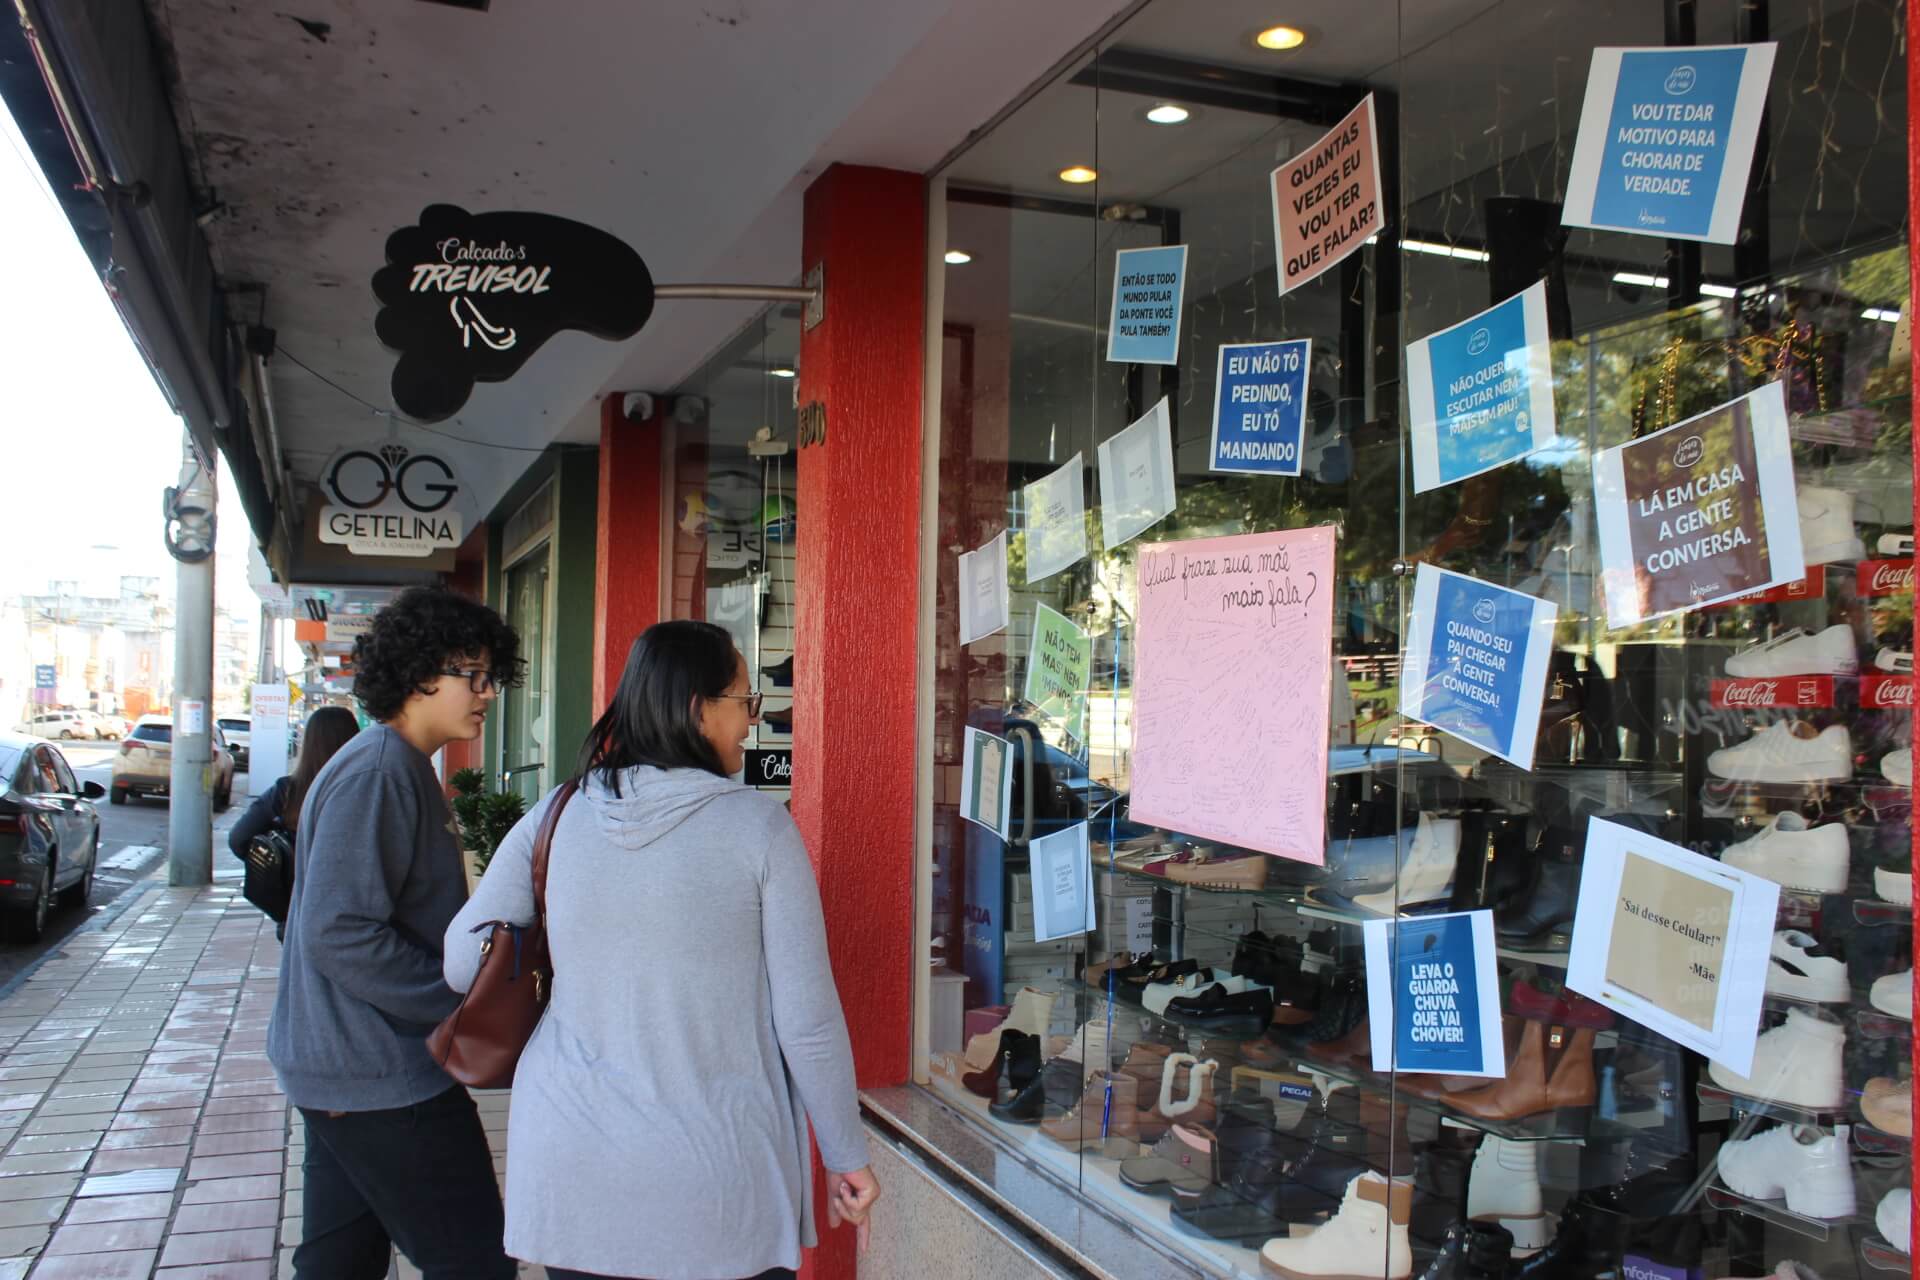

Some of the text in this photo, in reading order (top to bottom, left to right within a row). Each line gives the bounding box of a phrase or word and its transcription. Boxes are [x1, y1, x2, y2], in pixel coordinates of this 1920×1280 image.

[1632, 104, 1714, 122] VOU TE DAR
[1618, 128, 1716, 146] MOTIVO PARA
[1291, 121, 1359, 187] QUANTAS
[1621, 151, 1704, 171] CHORAR DE
[1292, 150, 1361, 216] VEZES EU
[1624, 176, 1691, 196] VERDADE.
[1299, 183, 1360, 240] VOU TER
[436, 238, 526, 264] Calçados
[1287, 202, 1375, 276] QUE FALAR?
[410, 264, 551, 294] TREVISOL
[1122, 272, 1176, 286] ENTÃO SE TODO
[1123, 291, 1172, 302] MUNDO PULAR
[1120, 304, 1174, 320] DA PONTE VOCÊ
[1120, 322, 1170, 336] PULA TAMBÉM?
[1228, 348, 1299, 375] EU NÃO TÔ
[1232, 383, 1292, 405] PEDINDO,
[1446, 376, 1519, 418] ESCUTAR NEM
[1450, 373, 1474, 396] NÃO
[1242, 408, 1280, 432] EU TÔ
[1450, 416, 1478, 436] MAIS
[1479, 409, 1496, 425] UM
[1497, 396, 1518, 418] PIU!
[1219, 442, 1294, 461] MANDANDO
[1640, 463, 1744, 518] LÁ EM CASA
[330, 513, 454, 541] GETELINA
[1658, 498, 1733, 542] A GENTE
[1646, 526, 1752, 575] CONVERSA.
[1144, 551, 1176, 594] Qual
[1222, 555, 1253, 575] sua
[1258, 544, 1290, 572] mãe
[1222, 582, 1264, 612] mais
[1045, 629, 1080, 664] NÃO TEM
[1447, 620, 1512, 654] QUANDO SEU
[1448, 640, 1506, 672] PAI CHEGAR
[1064, 666, 1080, 690] NEM
[1454, 660, 1495, 688] A GENTE
[1442, 675, 1500, 708] CONVERSA!
[761, 754, 792, 780] Calç
[1642, 907, 1670, 928] desse
[1412, 963, 1453, 980] LEVA O
[1409, 979, 1459, 995] GUARDA
[1415, 995, 1456, 1010] CHUVA
[1412, 1011, 1460, 1027] QUE VAI
[1411, 1027, 1464, 1042] CHOVER!
